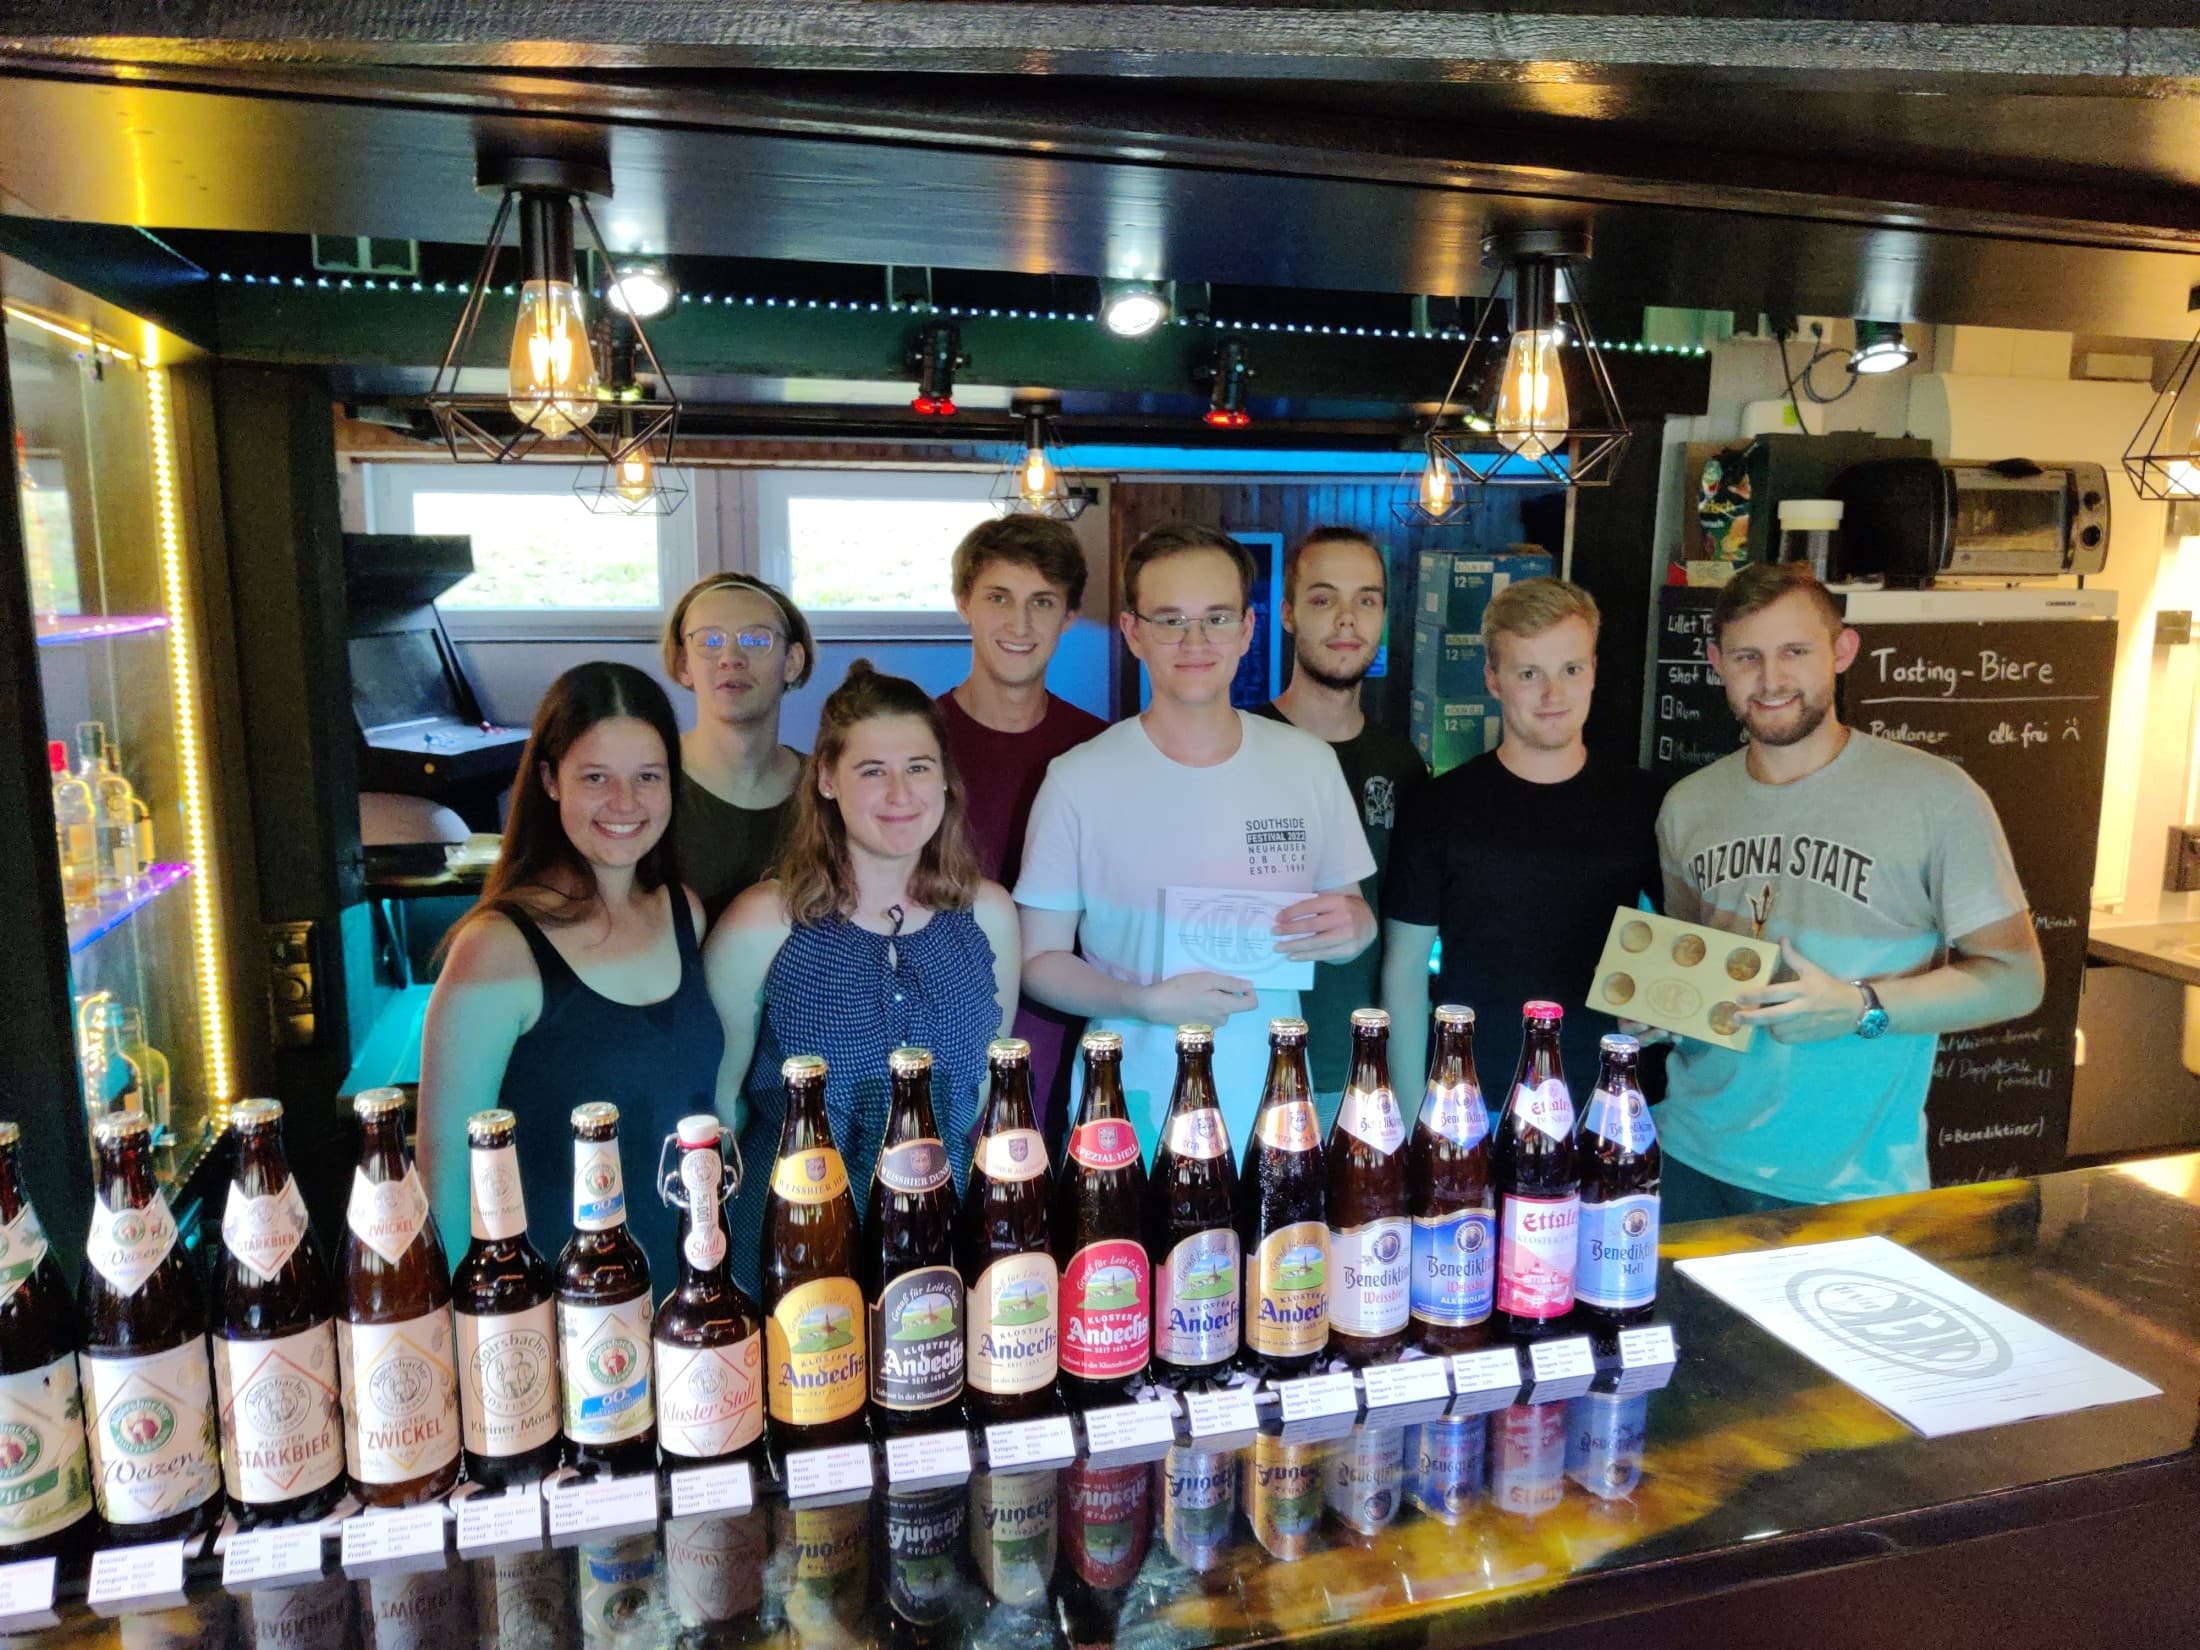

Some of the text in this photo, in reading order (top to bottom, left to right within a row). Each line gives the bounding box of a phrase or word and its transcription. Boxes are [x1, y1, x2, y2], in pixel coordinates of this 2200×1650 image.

[1454, 576, 1467, 588] 12
[1667, 613, 1698, 635] Lillet
[1446, 650, 1459, 661] 12
[1668, 665, 1699, 685] Shot
[1675, 701, 1700, 721] Rum
[1444, 719, 1457, 731] 12
[1245, 817, 1305, 832] SOUTHSIDE
[1247, 831, 1286, 844] FESTIVAL
[1248, 843, 1306, 855] NEUHAUSEN
[1688, 835, 1874, 904] RIZONA STATE
[1075, 1144, 1138, 1163] SPEZIAL HELL
[881, 1166, 929, 1188] WEISSBIER
[368, 1219, 416, 1238] ZWICKEL
[1093, 1258, 1107, 1272] für
[1109, 1255, 1128, 1265] Leib
[909, 1286, 924, 1301] für
[925, 1281, 944, 1294] Leib
[1280, 1292, 1321, 1304] KLOSTER
[1087, 1313, 1133, 1325] KLOSTER
[999, 1327, 1045, 1340] KLOSTER
[1066, 1312, 1149, 1346] Andechs
[903, 1339, 950, 1356] KLOSTER
[977, 1326, 1057, 1361] Andechs
[880, 1337, 964, 1378] Andechs
[779, 1352, 865, 1389] Andechs
[662, 1401, 717, 1424] Kloster
[367, 1418, 444, 1450] ZWICKEL
[471, 1417, 515, 1435] Kleiner
[235, 1433, 332, 1469] STARKBIER
[102, 1452, 194, 1485] Weizen
